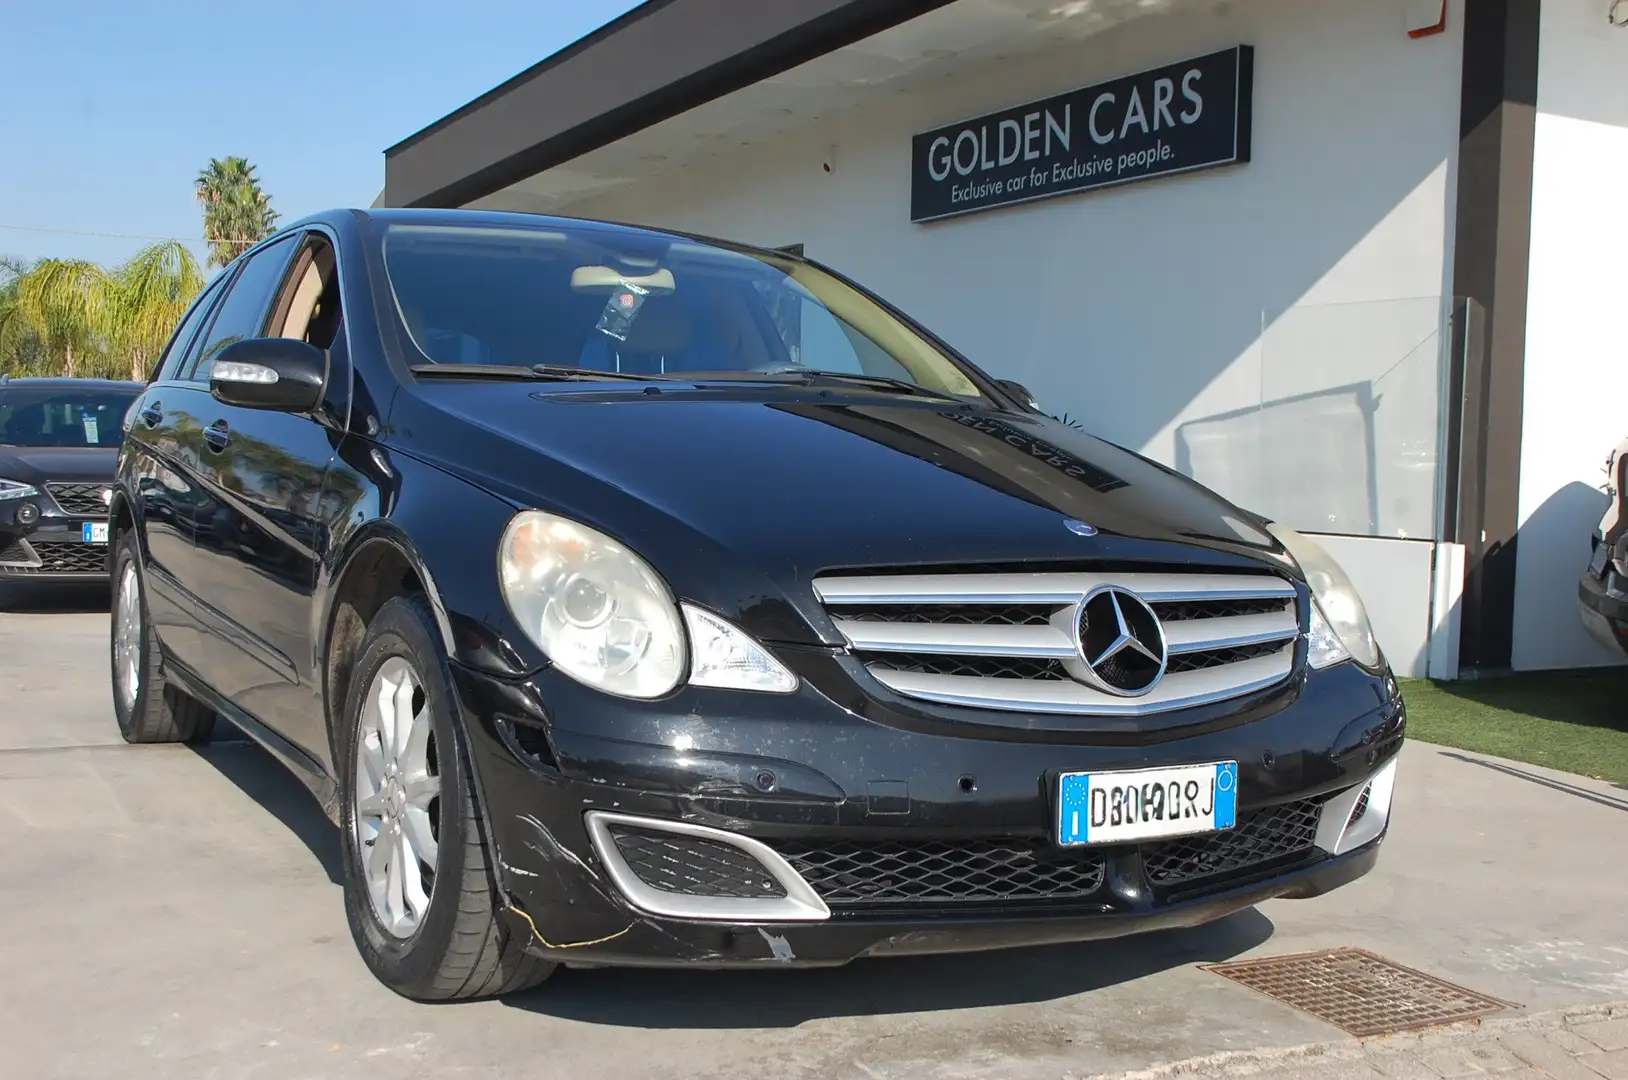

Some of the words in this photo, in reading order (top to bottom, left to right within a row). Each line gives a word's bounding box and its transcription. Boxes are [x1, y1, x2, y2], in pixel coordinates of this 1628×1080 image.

[928, 104, 1071, 181] GOLDEN
[1089, 69, 1203, 145] CARS
[951, 181, 1003, 203] Exclusive
[1006, 178, 1027, 193] car
[1030, 167, 1048, 186] for
[1052, 155, 1113, 184] Exclusive
[1117, 139, 1175, 175] people.
